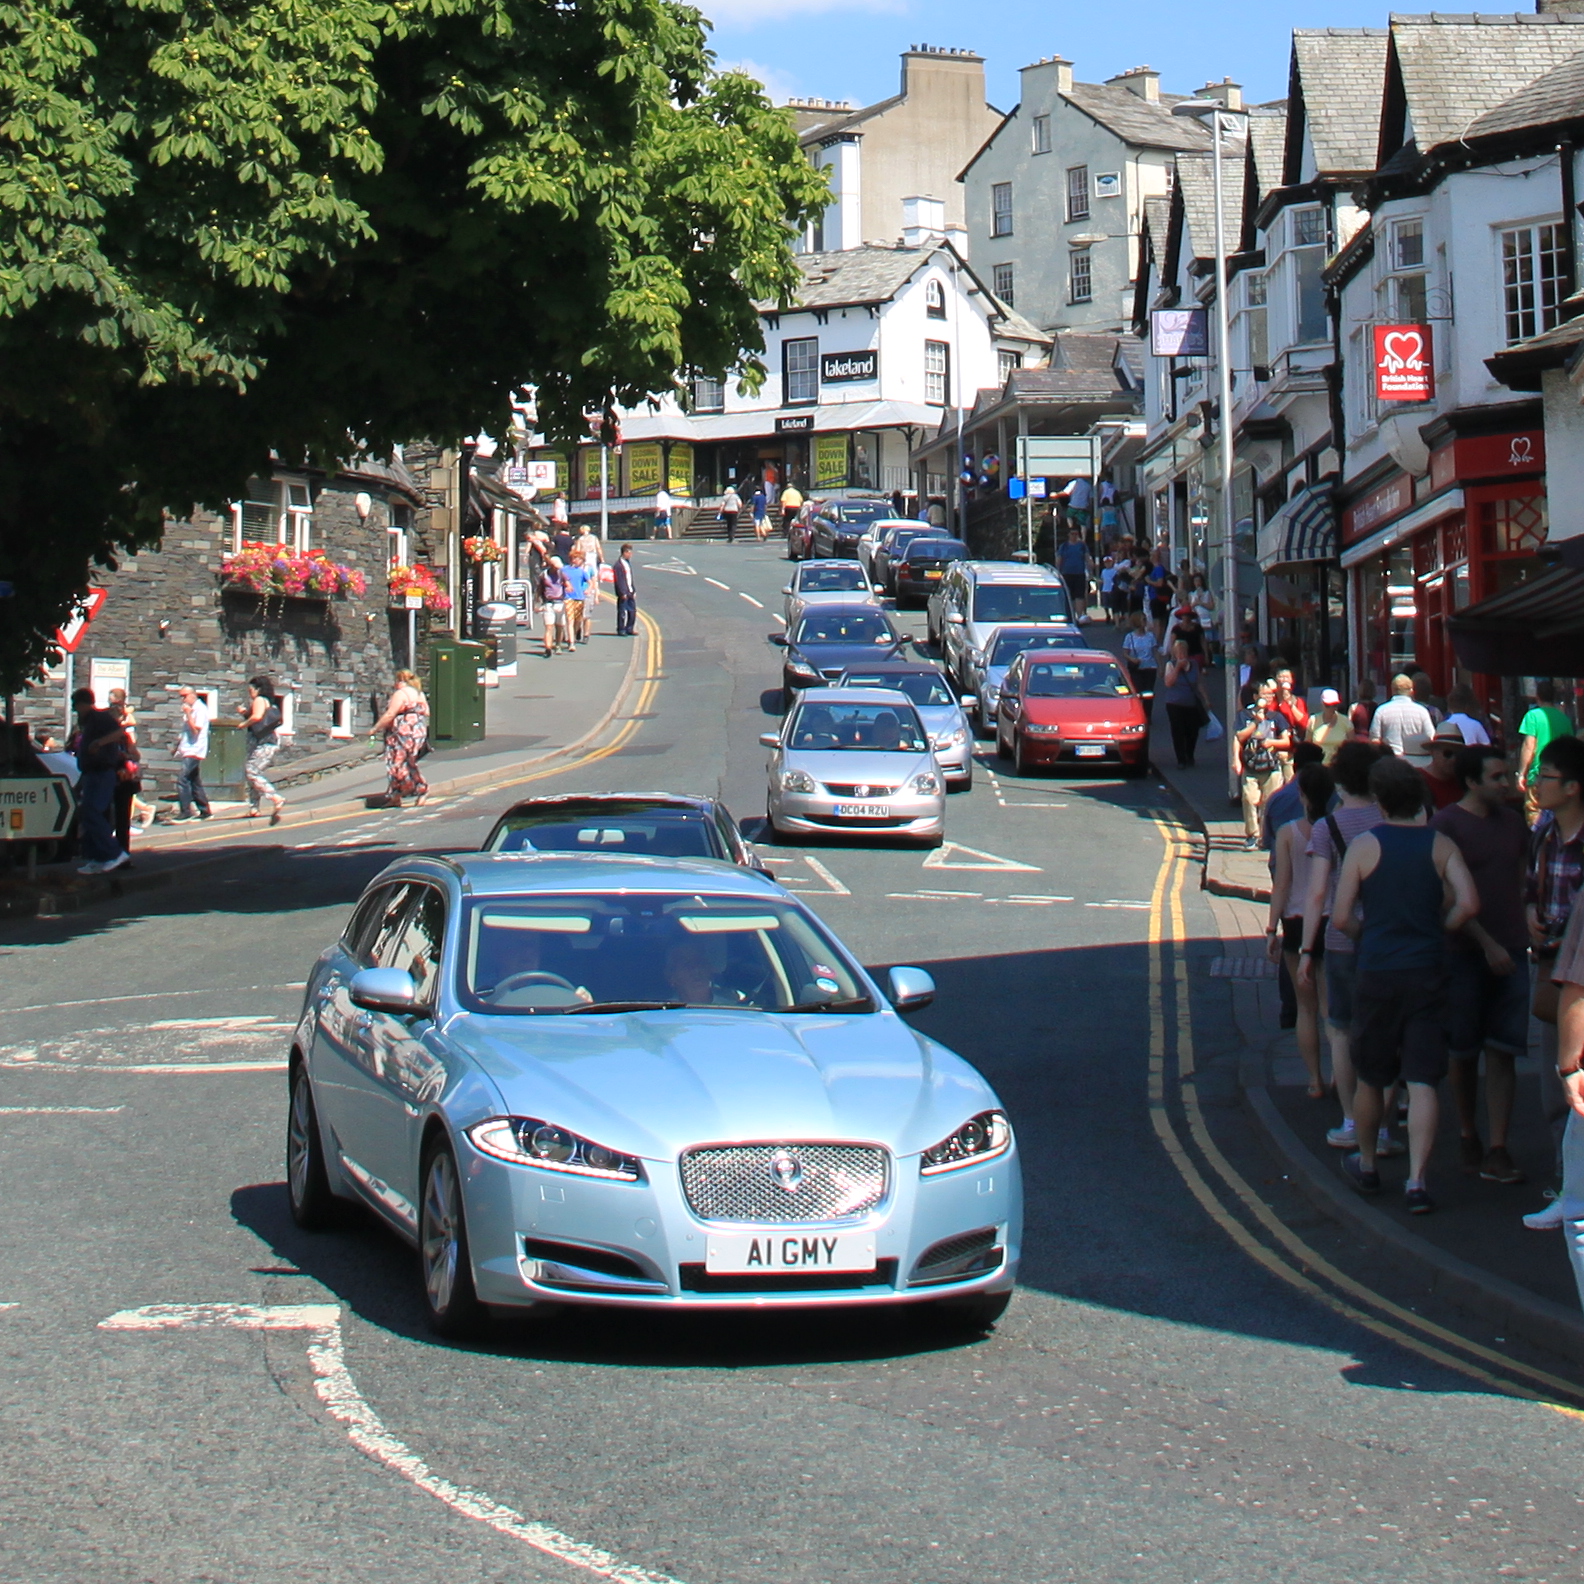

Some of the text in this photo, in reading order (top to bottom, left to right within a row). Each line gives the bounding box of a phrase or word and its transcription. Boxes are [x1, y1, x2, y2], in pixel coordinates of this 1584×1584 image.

[824, 355, 874, 378] lakeland
[1381, 374, 1428, 383] British Heart
[1381, 382, 1430, 392] Foundation
[781, 417, 807, 429] lakeland
[818, 449, 844, 459] DOWN
[632, 457, 657, 468] DOWN
[818, 461, 844, 474] SALE
[632, 469, 657, 483] SALE
[670, 469, 690, 483] SALE
[42, 786, 49, 803] 1
[781, 1236, 838, 1266] GMY
